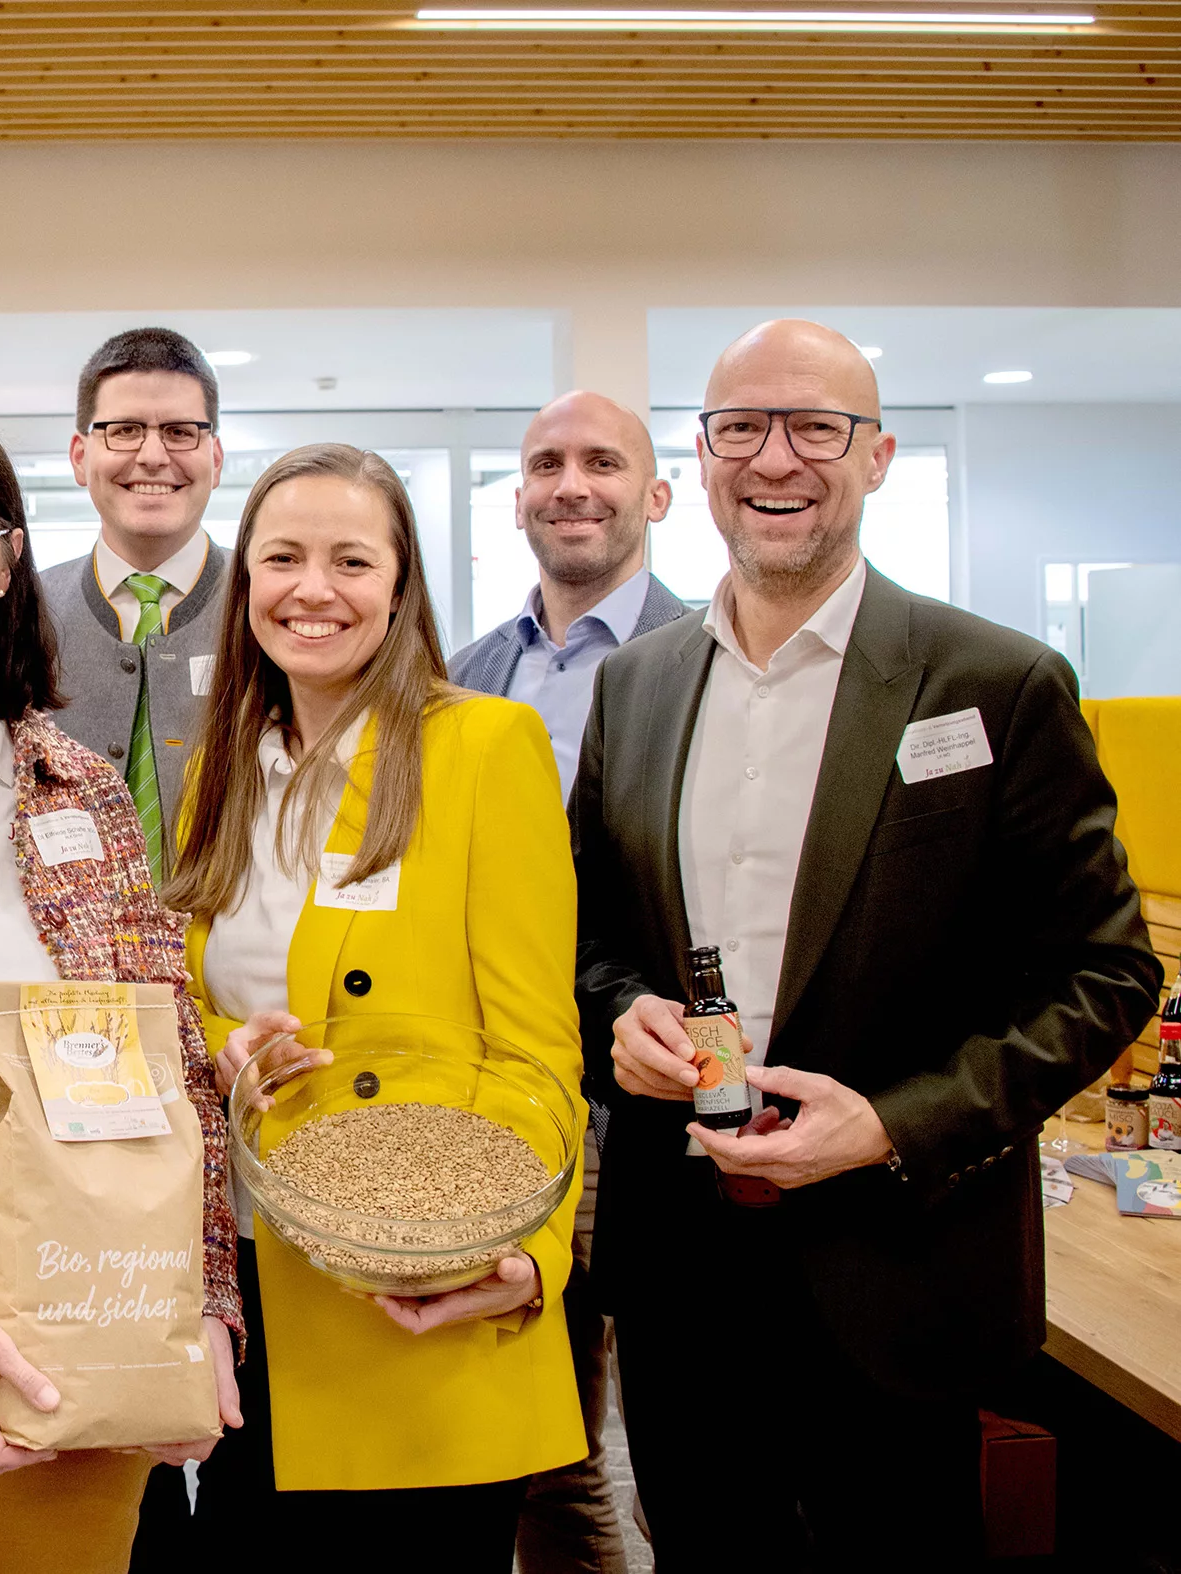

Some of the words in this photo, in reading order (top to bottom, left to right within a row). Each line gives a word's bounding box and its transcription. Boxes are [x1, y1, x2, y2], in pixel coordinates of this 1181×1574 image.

[910, 750, 936, 759] Manfred
[925, 768, 933, 778] Ja
[335, 891, 345, 900] Ja
[63, 1039, 105, 1049] Brenner's
[716, 1050, 730, 1058] BIO
[36, 1240, 92, 1280] Bio,
[98, 1238, 194, 1288] regional
[37, 1284, 98, 1322] und
[97, 1284, 178, 1328] sicher.
